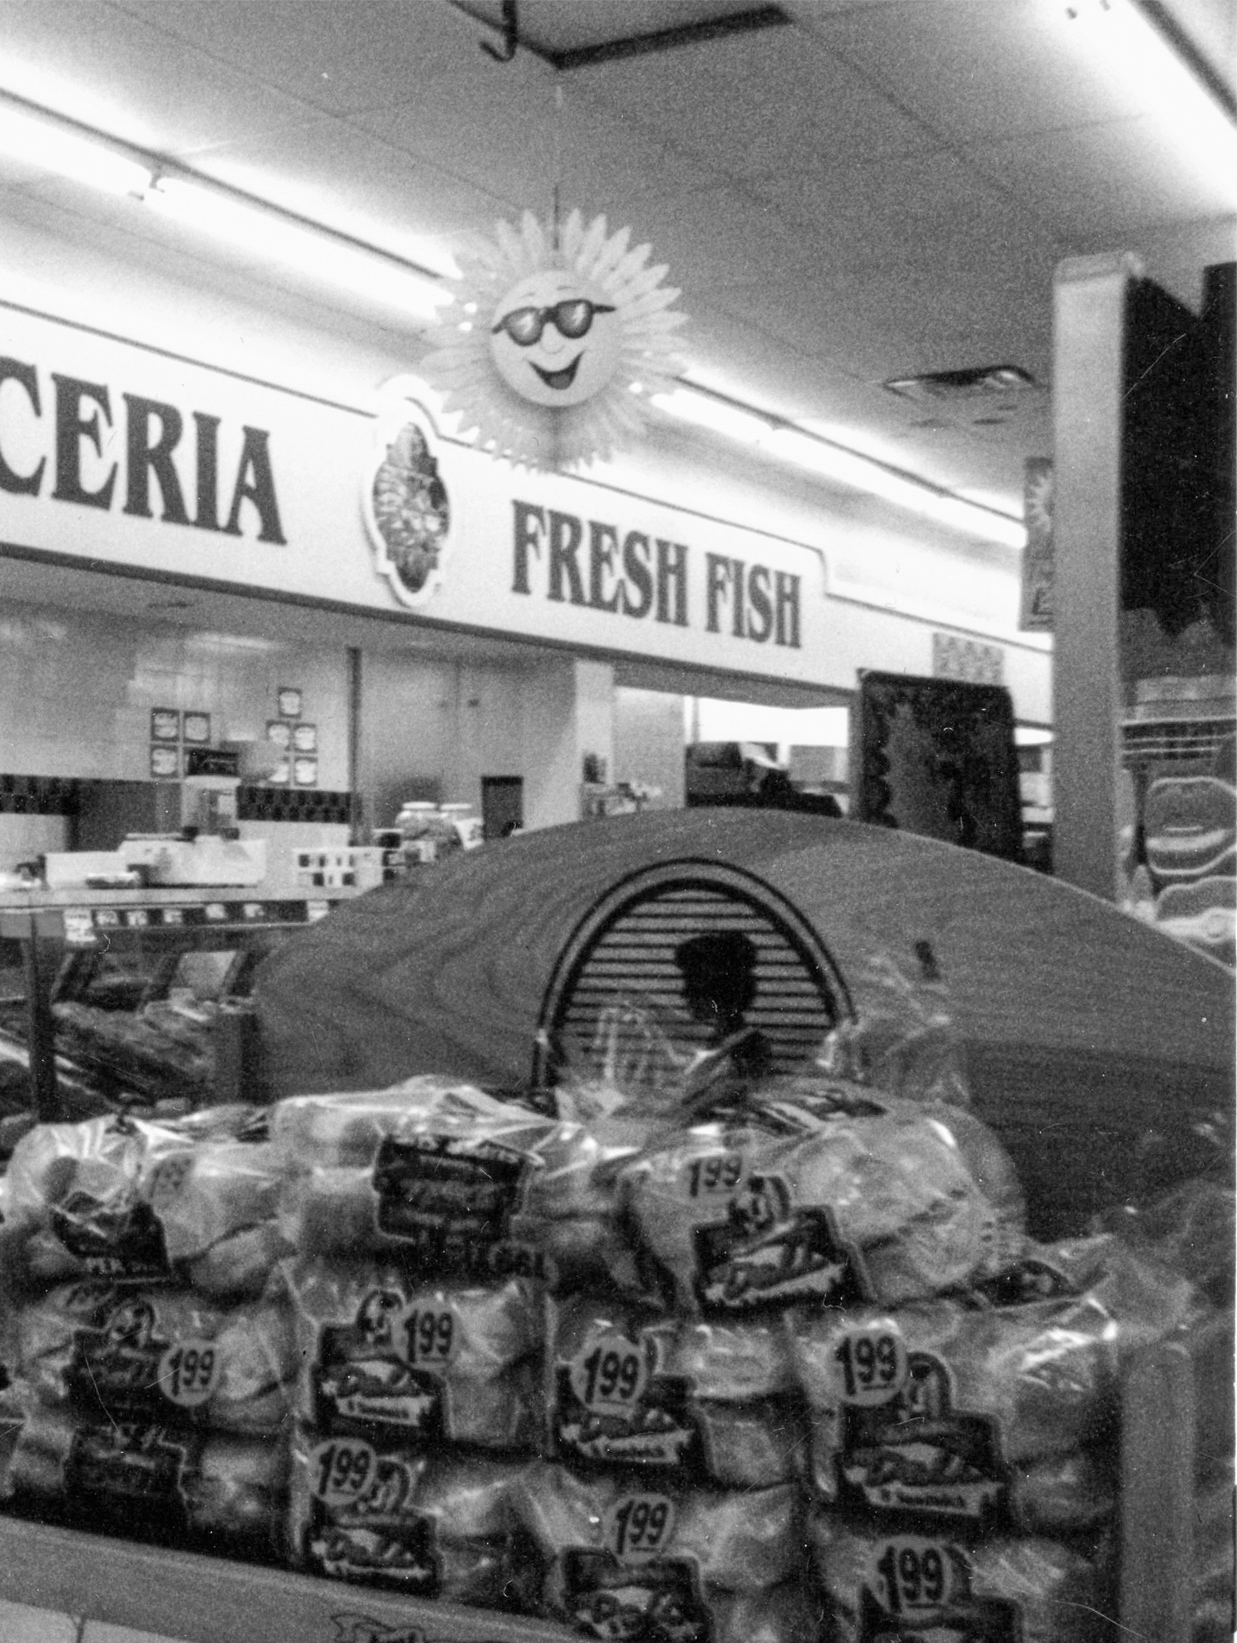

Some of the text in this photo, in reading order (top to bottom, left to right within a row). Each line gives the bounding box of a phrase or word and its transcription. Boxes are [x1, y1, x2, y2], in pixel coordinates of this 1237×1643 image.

[511, 498, 802, 650] FRESH FISH
[688, 1156, 742, 1198] 199
[403, 1309, 453, 1364] 199
[168, 1348, 214, 1398] 199
[584, 1347, 641, 1404] 199
[834, 1335, 896, 1397] 199
[318, 1444, 370, 1496] 199
[616, 1500, 669, 1556] 199
[877, 1545, 943, 1615] 199
